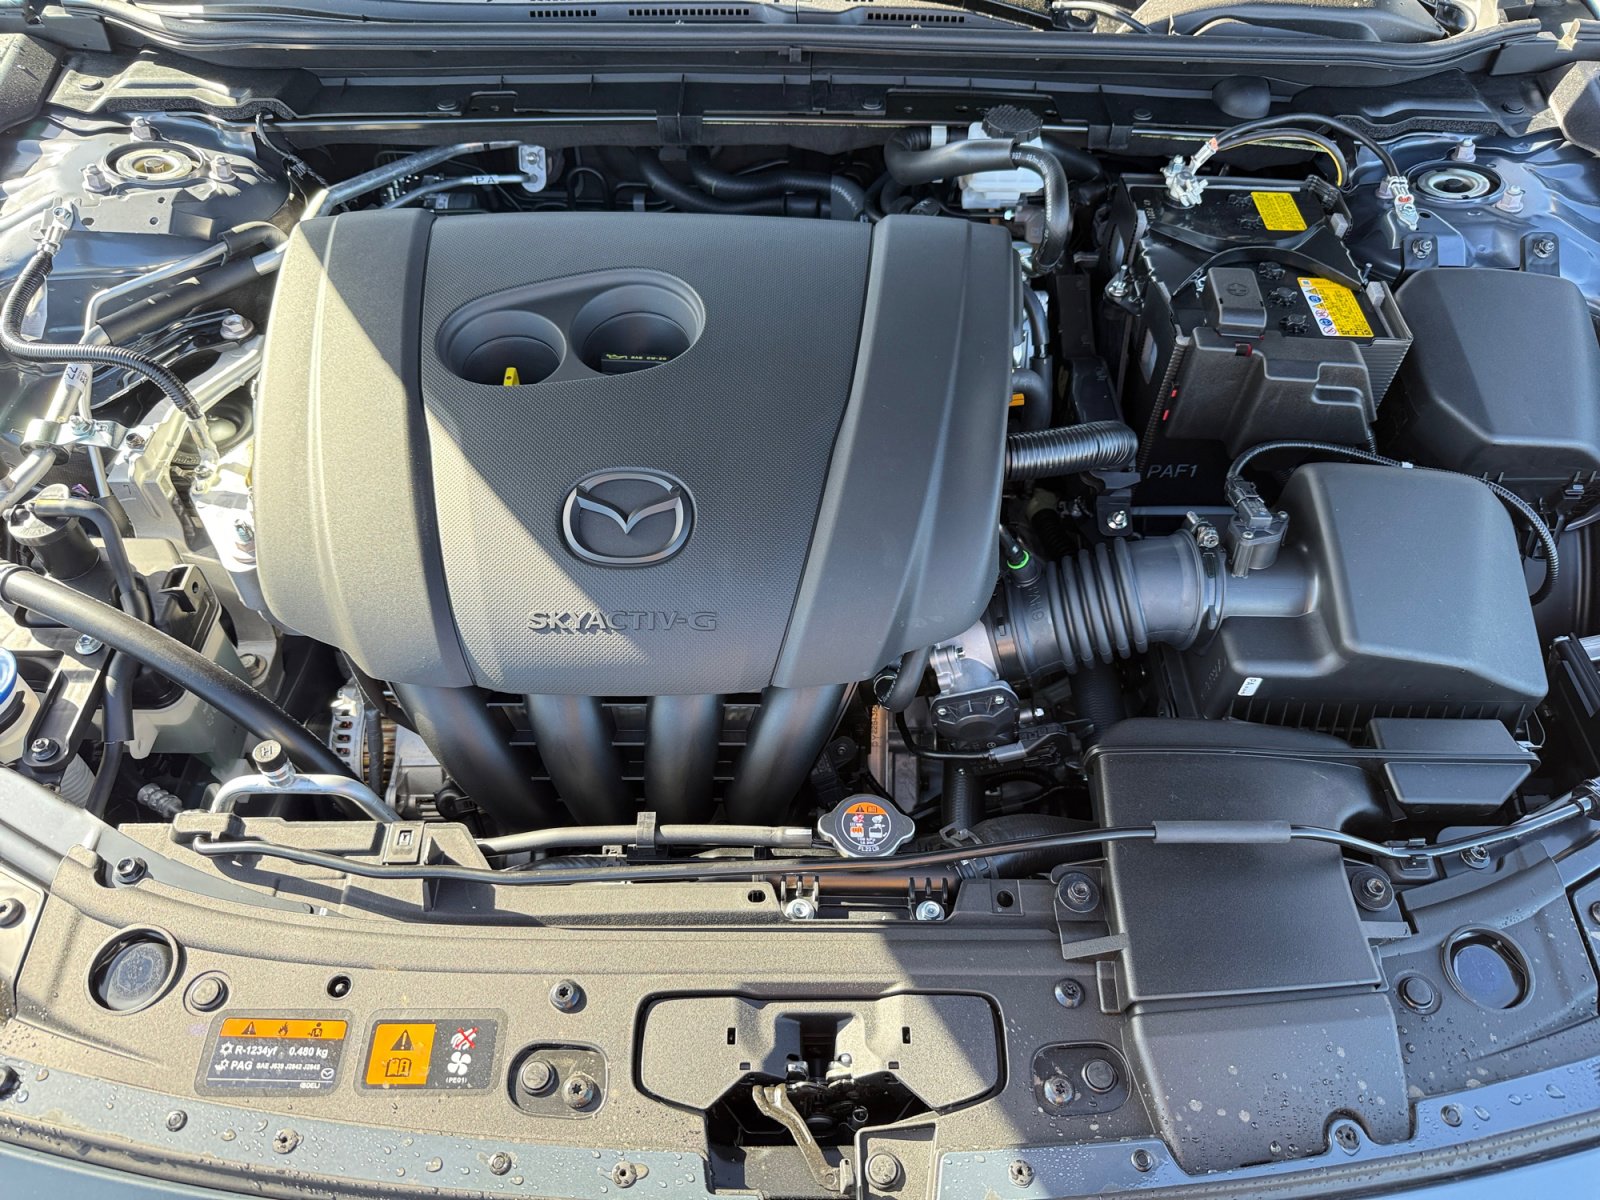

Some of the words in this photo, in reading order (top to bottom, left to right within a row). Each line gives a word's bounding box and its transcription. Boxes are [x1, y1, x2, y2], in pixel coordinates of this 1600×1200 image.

[1147, 464, 1198, 479] PAF1
[528, 611, 717, 632] SKYACTIV-G
[235, 1045, 278, 1057] R-1234yf
[289, 1047, 314, 1056] 0.480
[316, 1047, 329, 1058] kg
[231, 1061, 253, 1070] PAG
